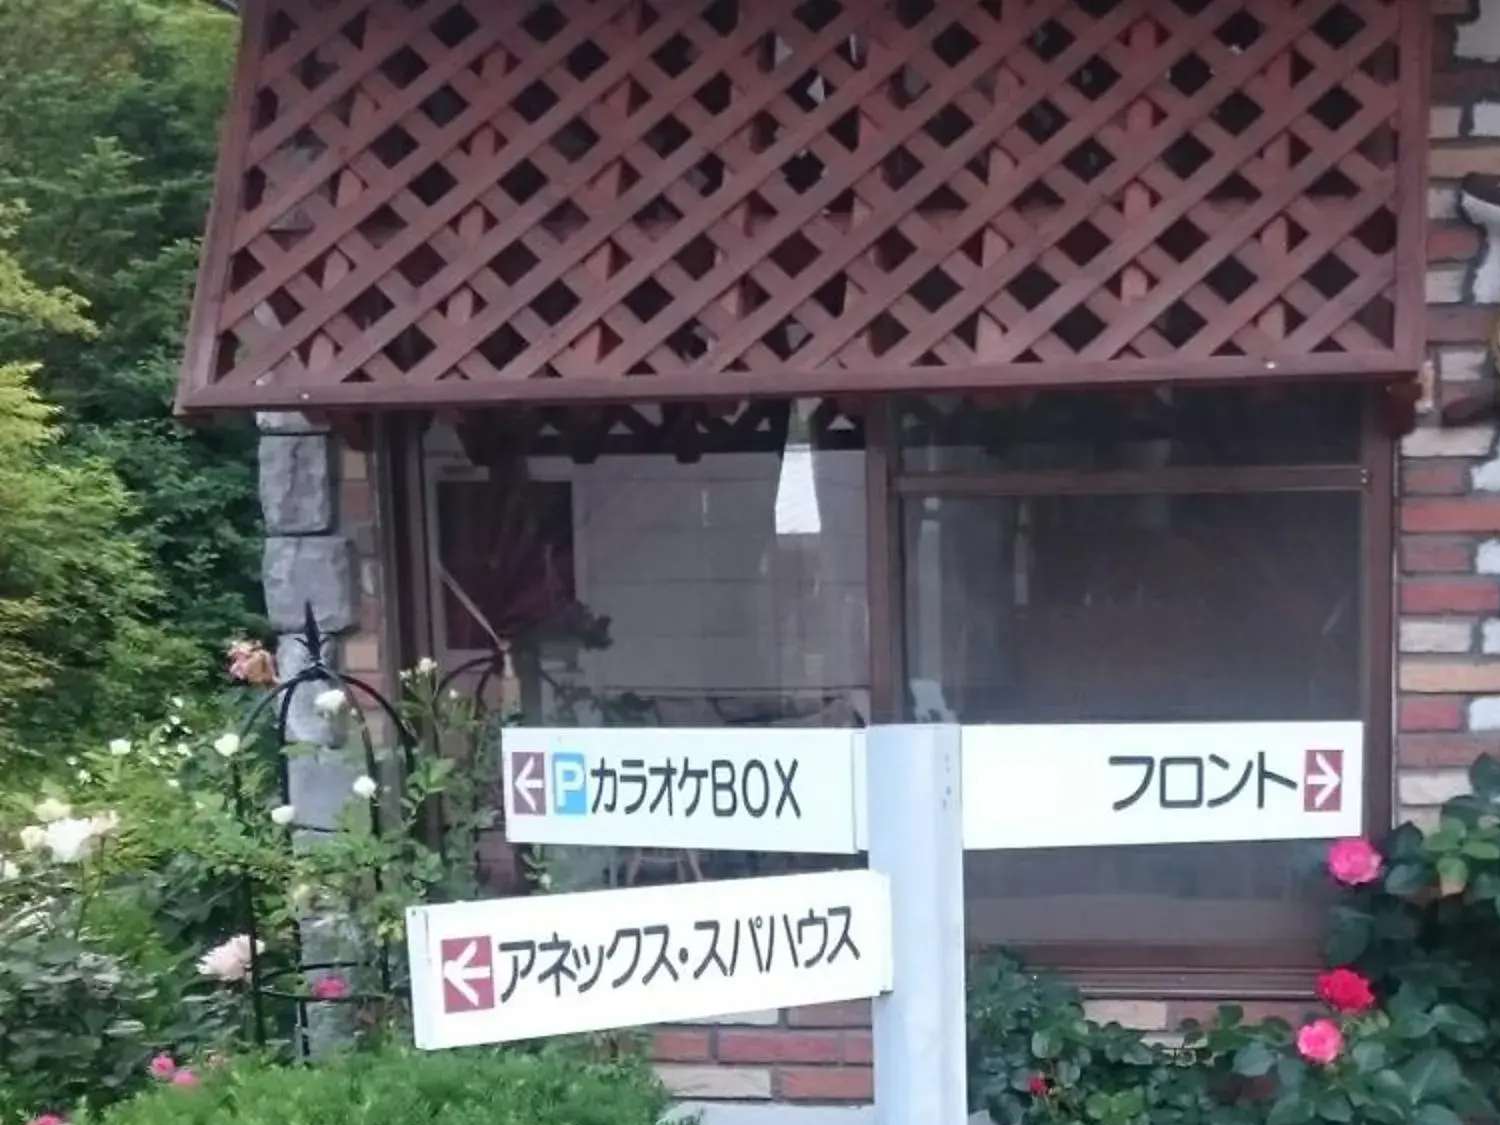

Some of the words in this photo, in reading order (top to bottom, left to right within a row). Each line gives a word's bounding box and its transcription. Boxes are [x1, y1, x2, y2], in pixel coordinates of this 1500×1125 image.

[590, 757, 802, 818] カラオケBOX
[1108, 751, 1298, 811] フロント
[498, 906, 861, 1003] アネックス・スパハウス
